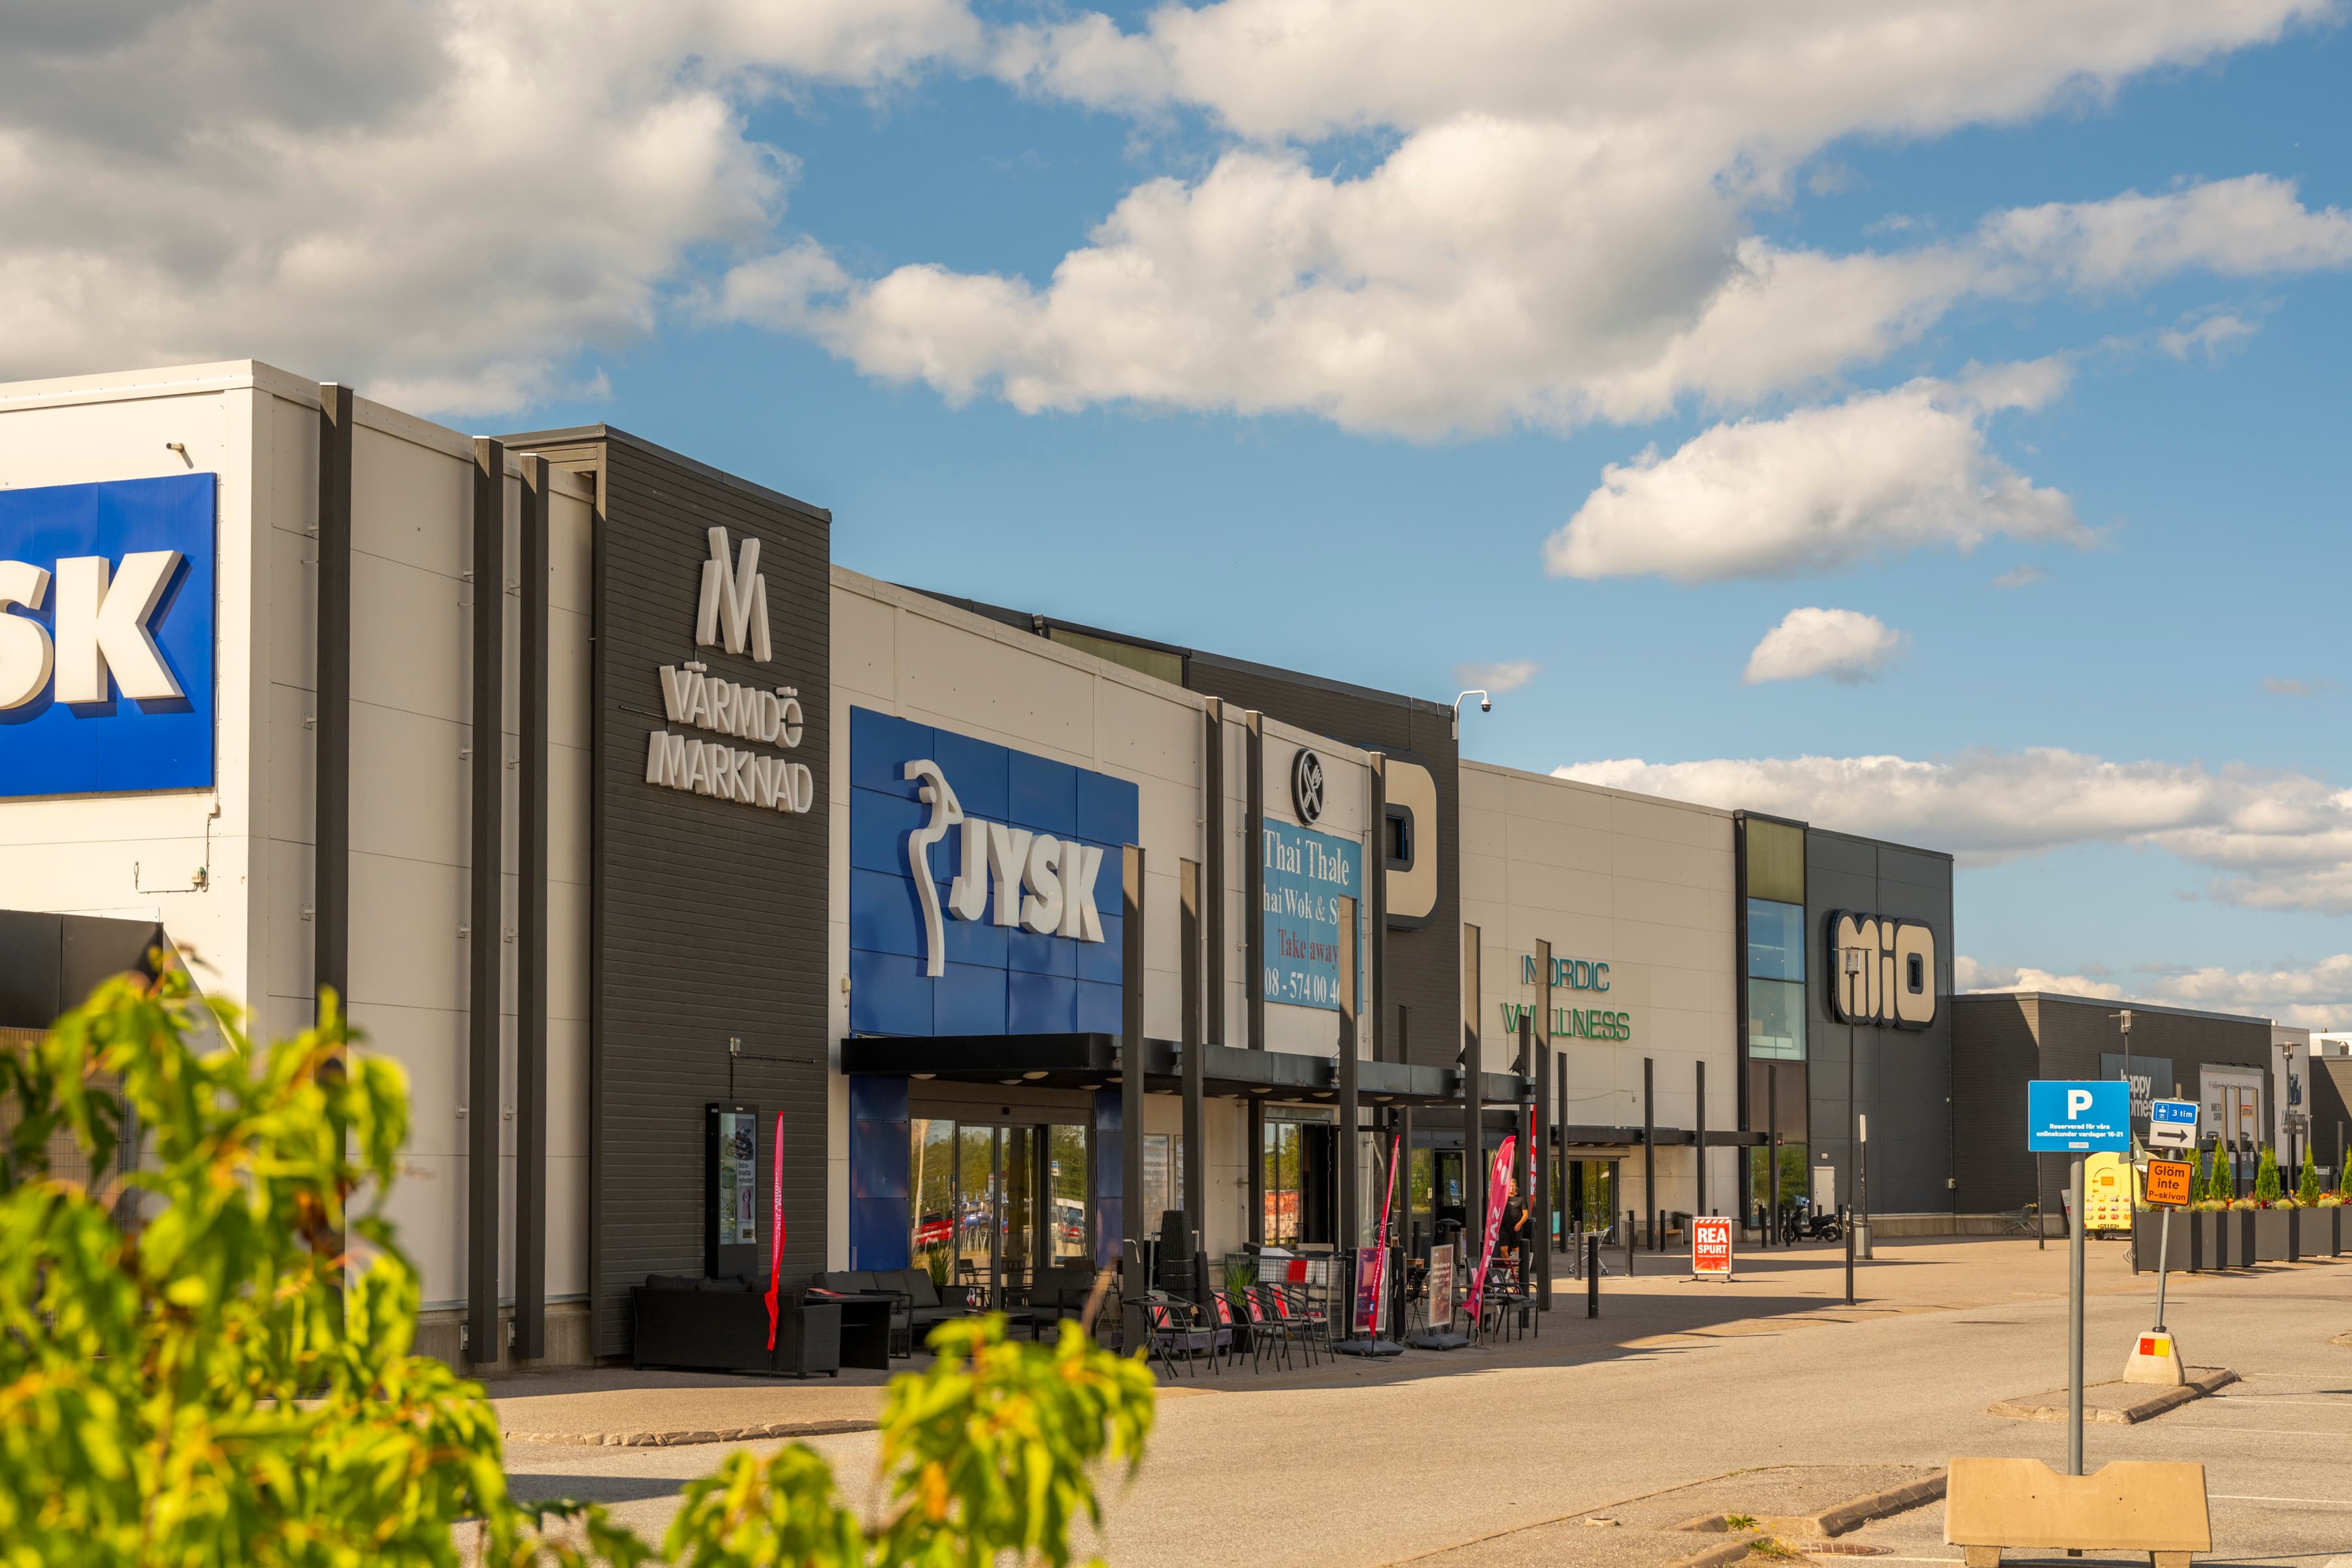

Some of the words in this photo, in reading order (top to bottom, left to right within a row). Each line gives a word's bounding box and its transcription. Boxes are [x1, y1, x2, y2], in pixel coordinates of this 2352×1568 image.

[660, 661, 804, 748] VÄRMDÖ
[646, 730, 813, 813] MARKNAD
[1264, 828, 1301, 874] Thai
[1305, 839, 1349, 886] Thale
[948, 817, 1105, 943] JYSK
[1264, 883, 1282, 914] hai
[1284, 888, 1312, 919] Wok
[1315, 895, 1325, 922] &
[1330, 898, 1339, 925] S
[1279, 929, 1305, 959] Take
[1309, 941, 1338, 971] away
[1265, 967, 1279, 996] 08
[1290, 972, 1310, 1001] 574
[1313, 975, 1326, 1004] 00
[1330, 977, 1339, 1005] 4
[1503, 1003, 1630, 1041] WLNESS
[2068, 1090, 2093, 1120] P
[2130, 1098, 2153, 1118] mes
[2155, 1165, 2185, 1178] Glöm
[2157, 1178, 2180, 1190] inte
[2149, 1190, 2185, 1201] P-skivan
[1697, 1228, 1727, 1243] REA
[1697, 1244, 1727, 1254] SPURT
